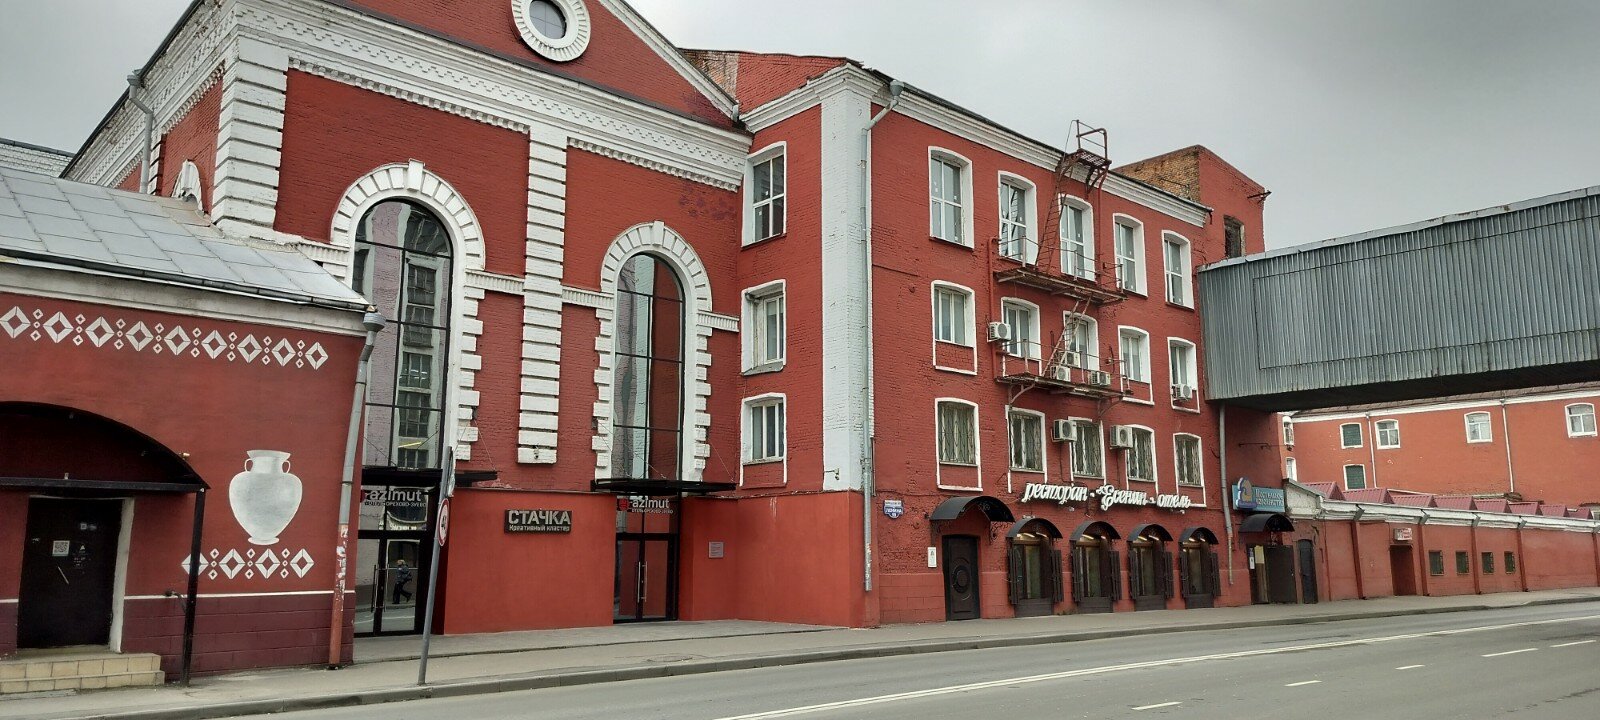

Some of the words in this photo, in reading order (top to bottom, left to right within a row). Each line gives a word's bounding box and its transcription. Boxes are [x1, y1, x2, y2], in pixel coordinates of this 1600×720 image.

[369, 489, 422, 502] azimut
[1021, 483, 1088, 505] ресторан
[1096, 484, 1147, 511] Есенин
[1157, 493, 1191, 509] отель
[632, 498, 670, 509] azimut
[508, 510, 571, 525] СТАЧКА
